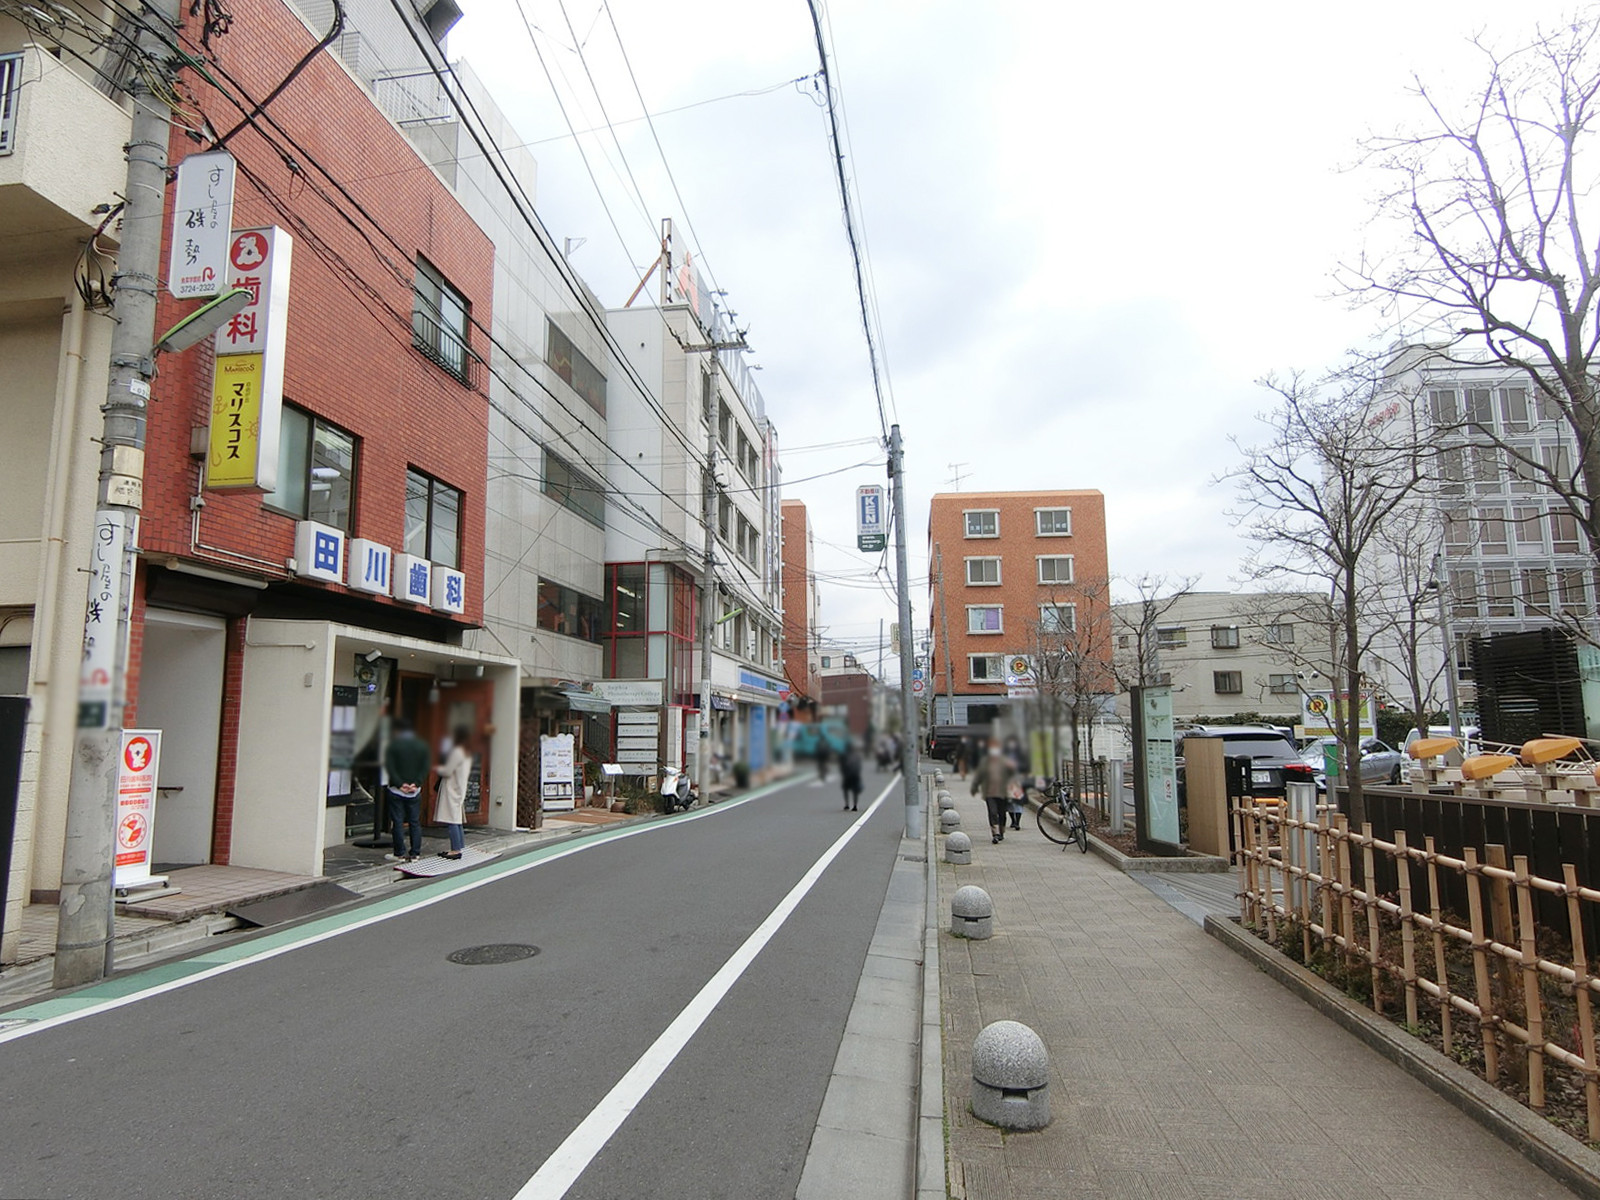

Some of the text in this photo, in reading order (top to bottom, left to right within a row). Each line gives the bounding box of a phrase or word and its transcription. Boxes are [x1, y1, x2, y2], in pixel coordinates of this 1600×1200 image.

[180, 283, 216, 294] 3724-2322
[226, 276, 262, 345] 歯科
[226, 382, 246, 460] マリスコス
[865, 496, 877, 524] KEN
[314, 530, 463, 609] 田川歯科
